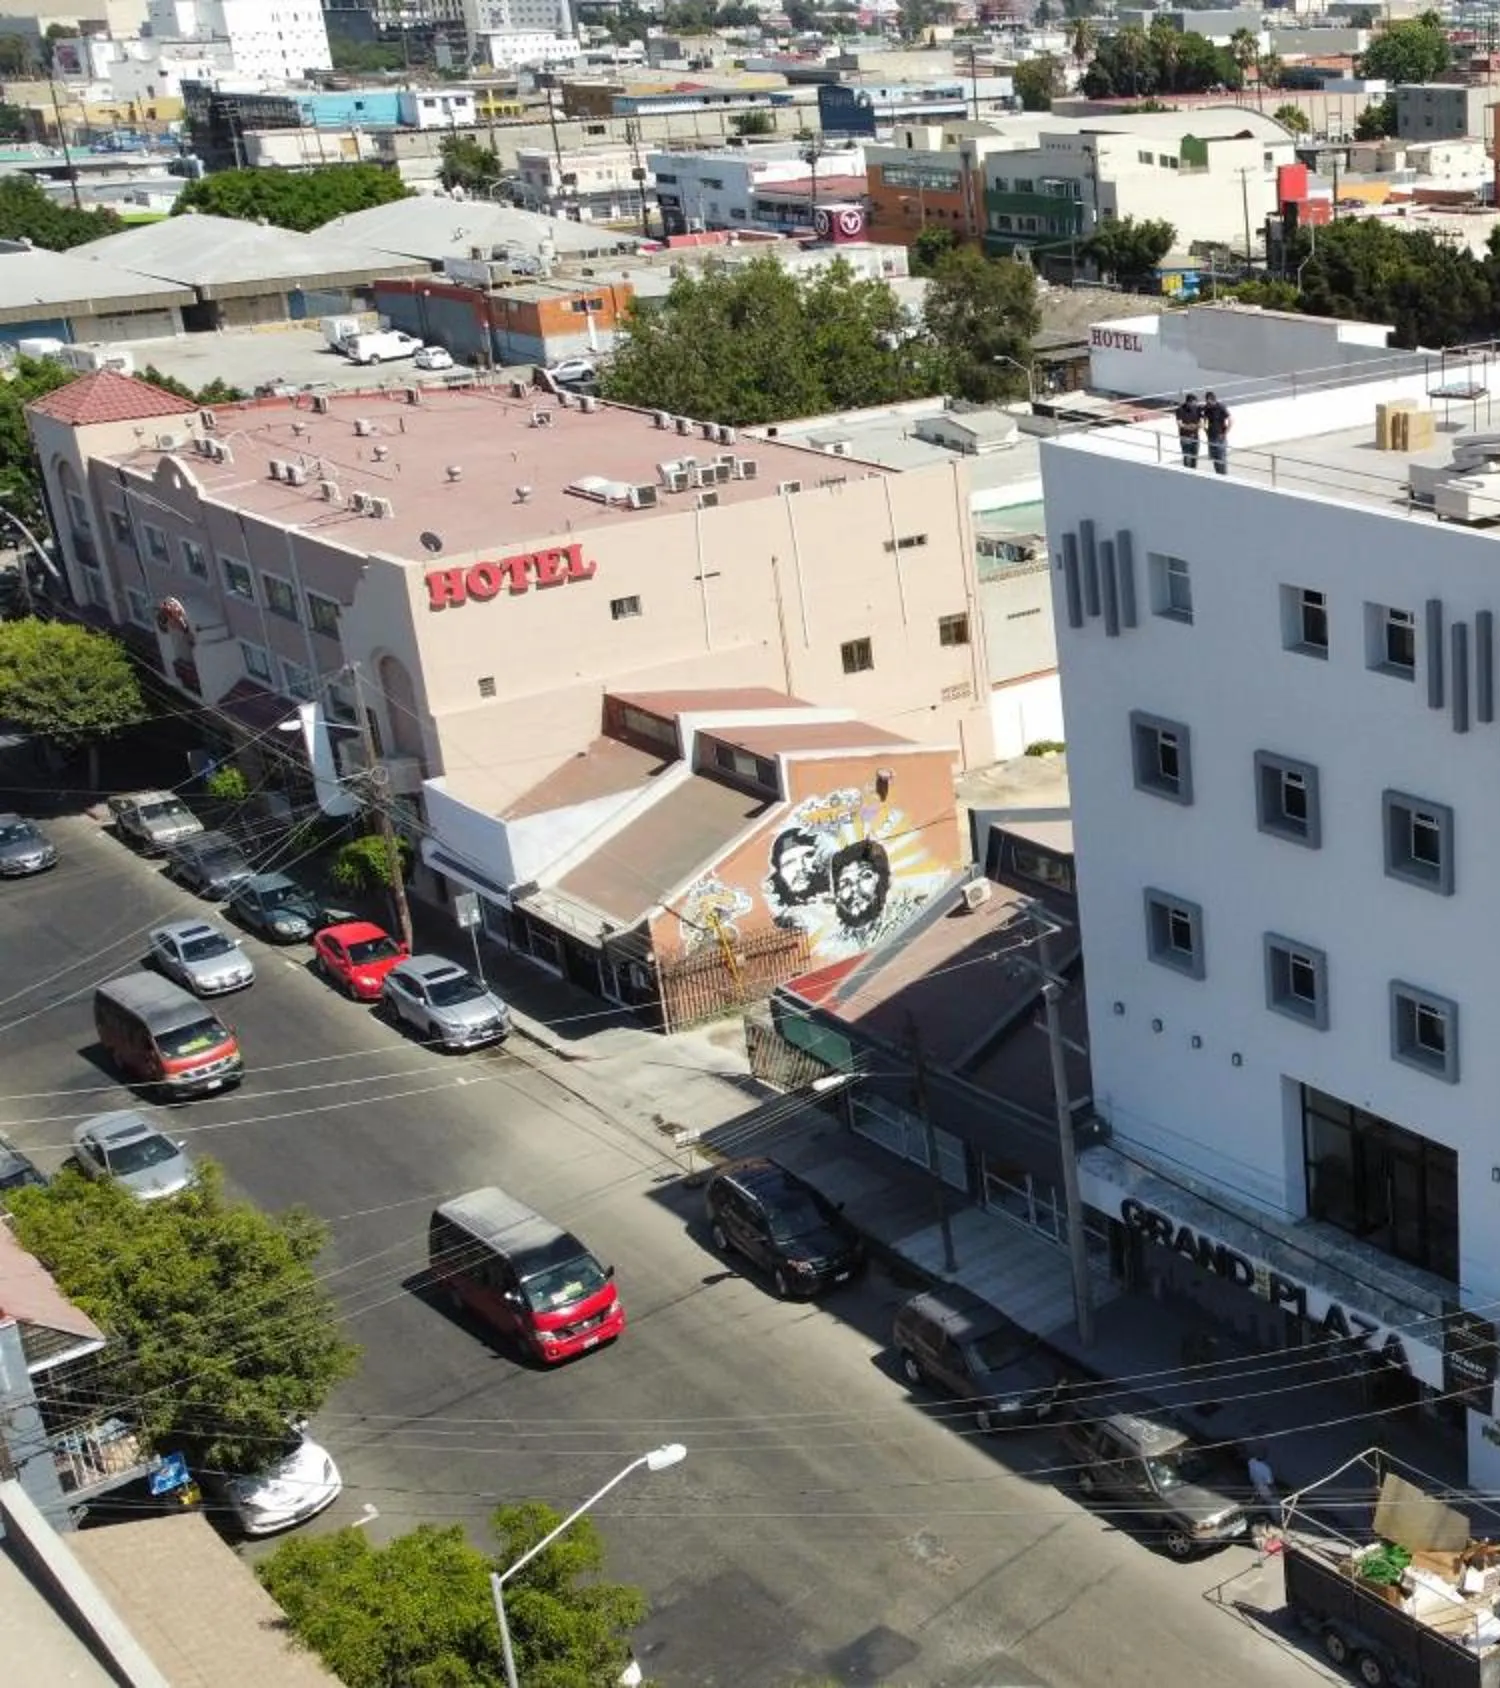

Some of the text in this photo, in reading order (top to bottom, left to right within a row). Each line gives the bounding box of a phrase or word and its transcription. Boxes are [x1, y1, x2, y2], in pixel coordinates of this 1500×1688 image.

[1091, 329, 1143, 352] HOTEL
[424, 543, 597, 612] HOTEL
[1121, 1198, 1413, 1378] GRAND PLAZA
